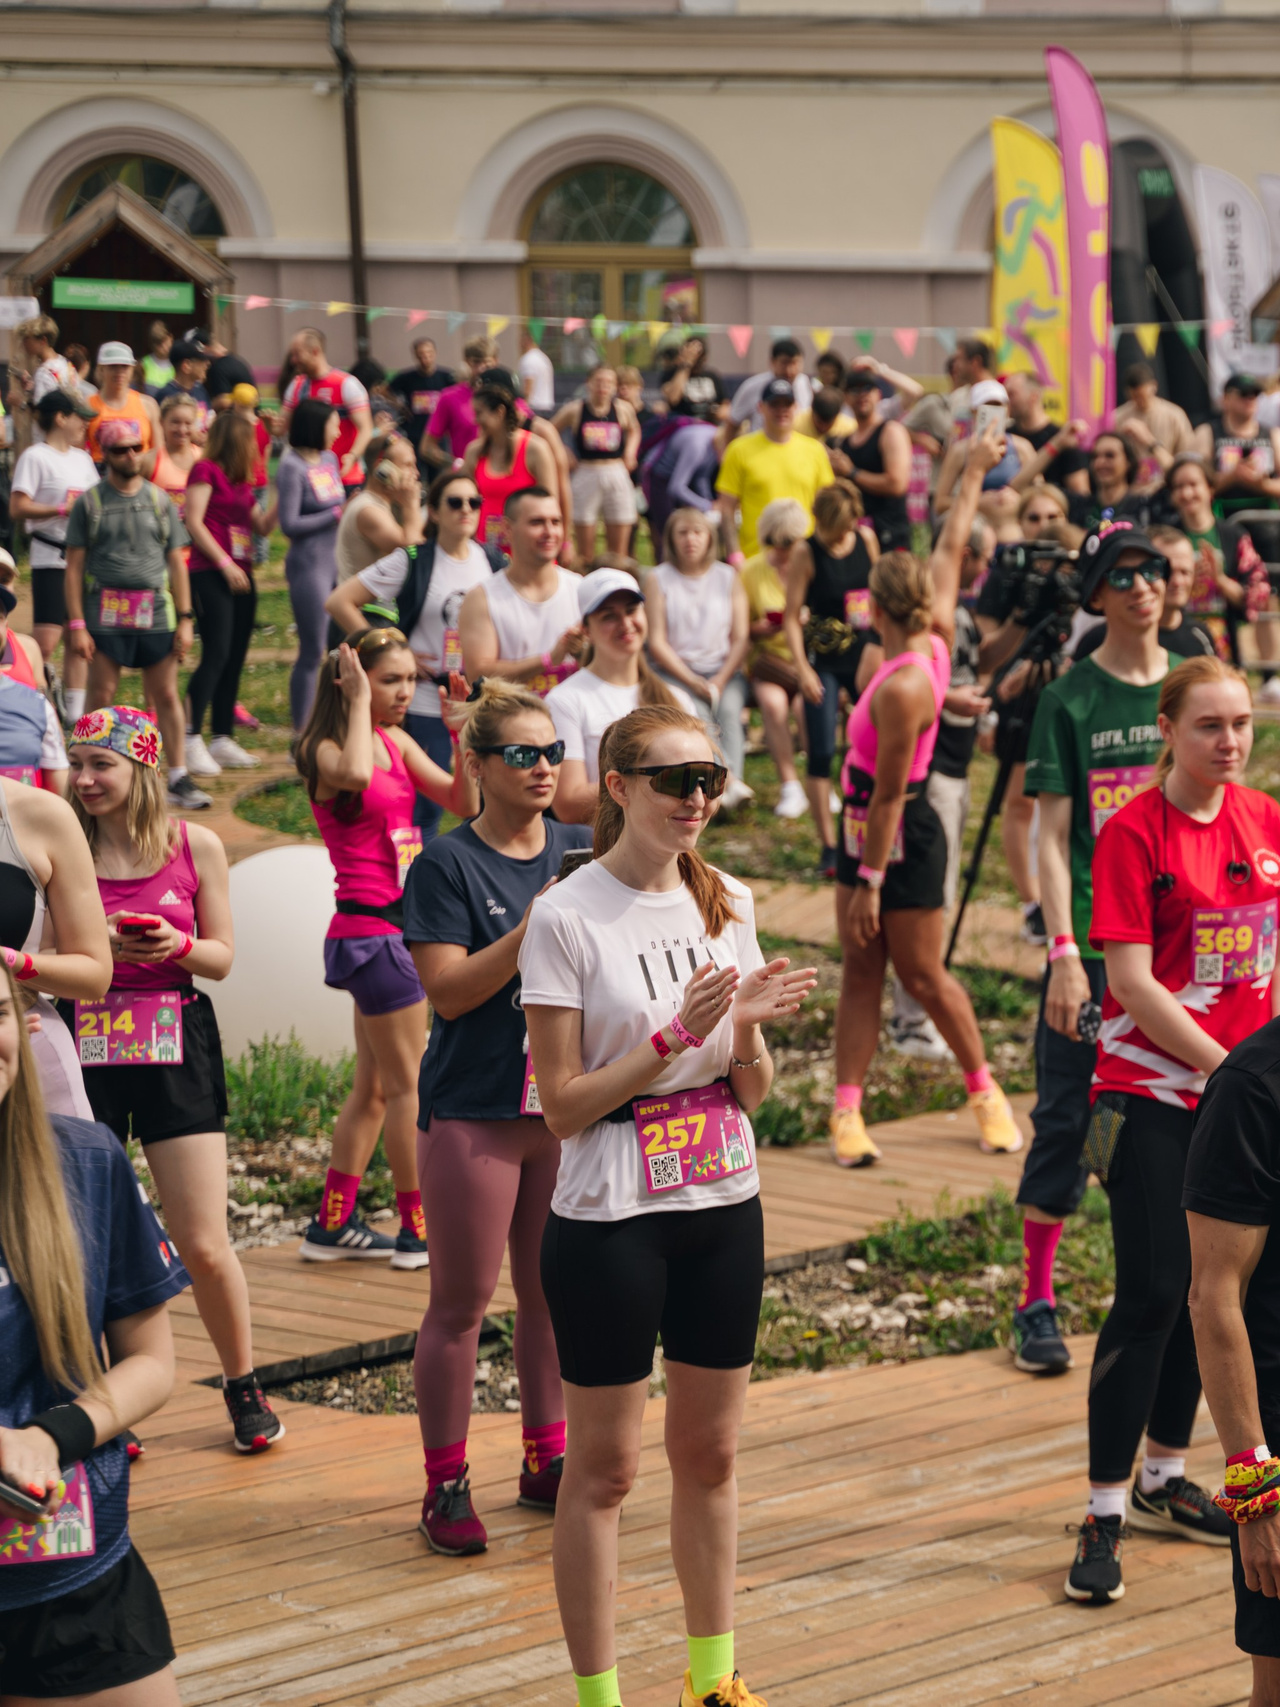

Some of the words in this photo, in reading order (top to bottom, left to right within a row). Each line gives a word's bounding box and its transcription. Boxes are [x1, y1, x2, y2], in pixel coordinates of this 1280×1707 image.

[650, 936, 704, 949] DEMIX
[1194, 925, 1254, 954] 369
[78, 1009, 136, 1037] 214
[639, 1102, 670, 1115] RUTS
[725, 1104, 733, 1116] 3
[641, 1113, 707, 1155] 257
